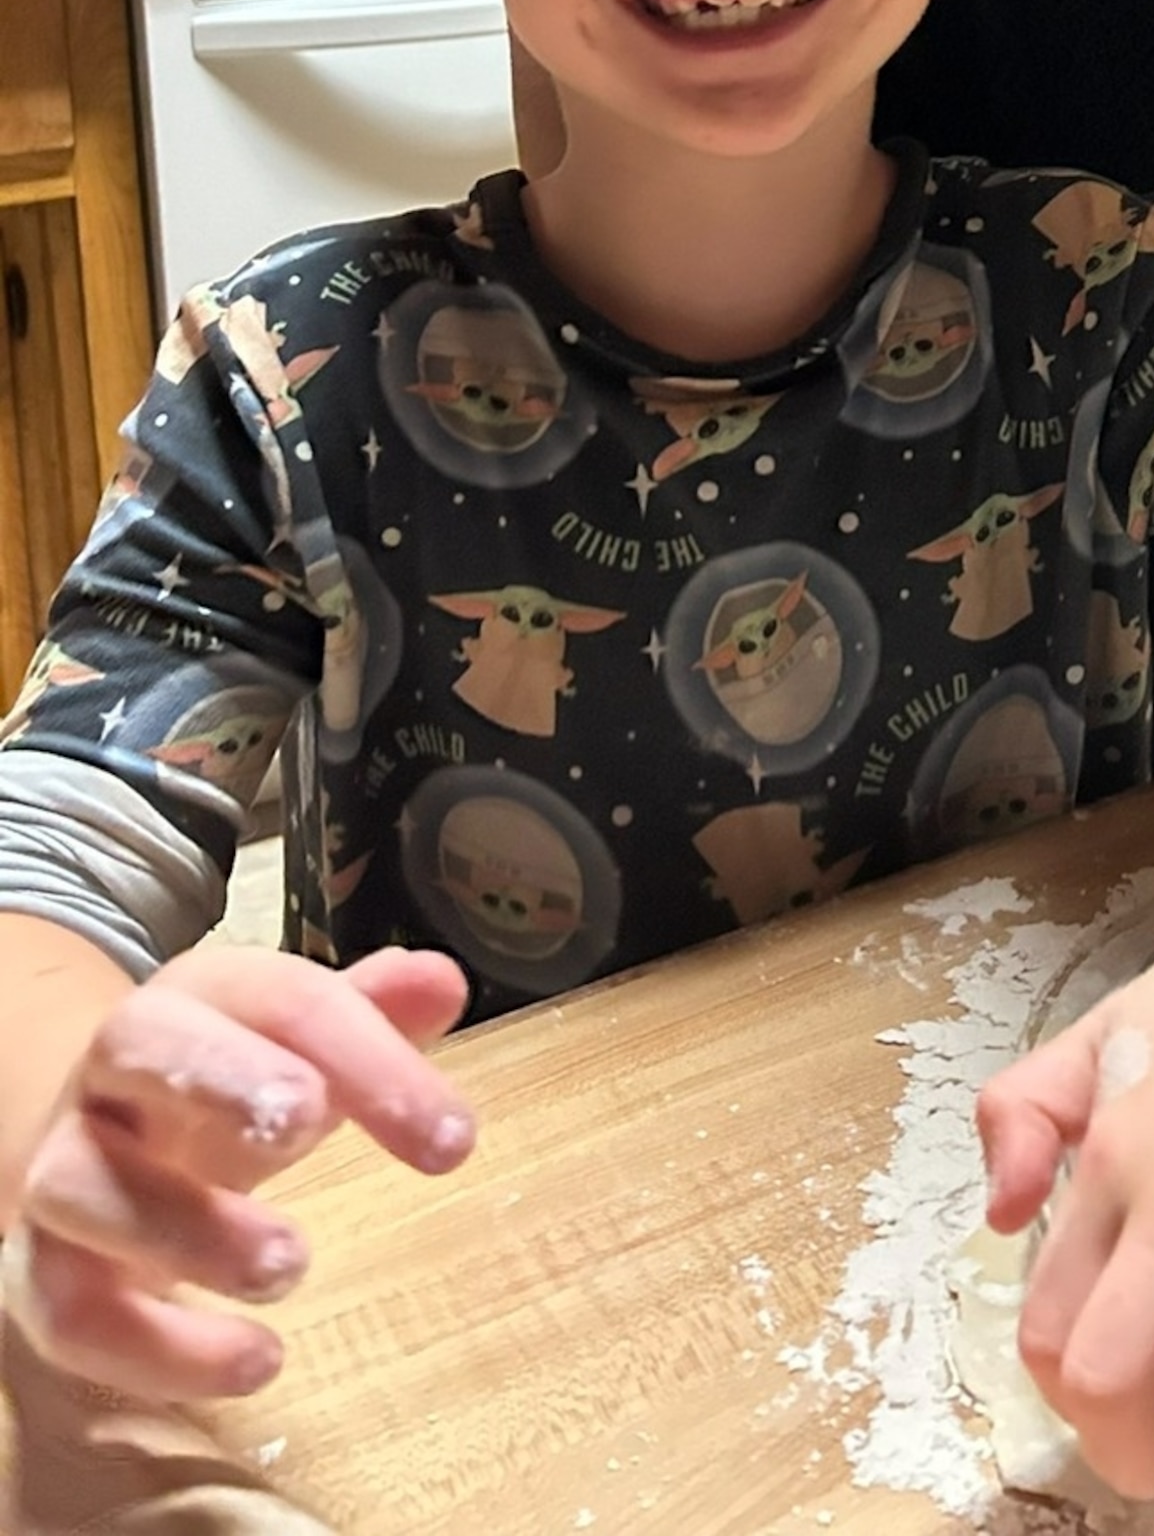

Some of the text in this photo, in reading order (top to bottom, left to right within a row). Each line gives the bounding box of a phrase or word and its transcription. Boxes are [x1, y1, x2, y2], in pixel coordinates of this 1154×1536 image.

[320, 260, 371, 304] THE
[551, 512, 705, 571] THE CHILD
[394, 723, 465, 764] CHILD
[854, 672, 968, 797] THE CHILD
